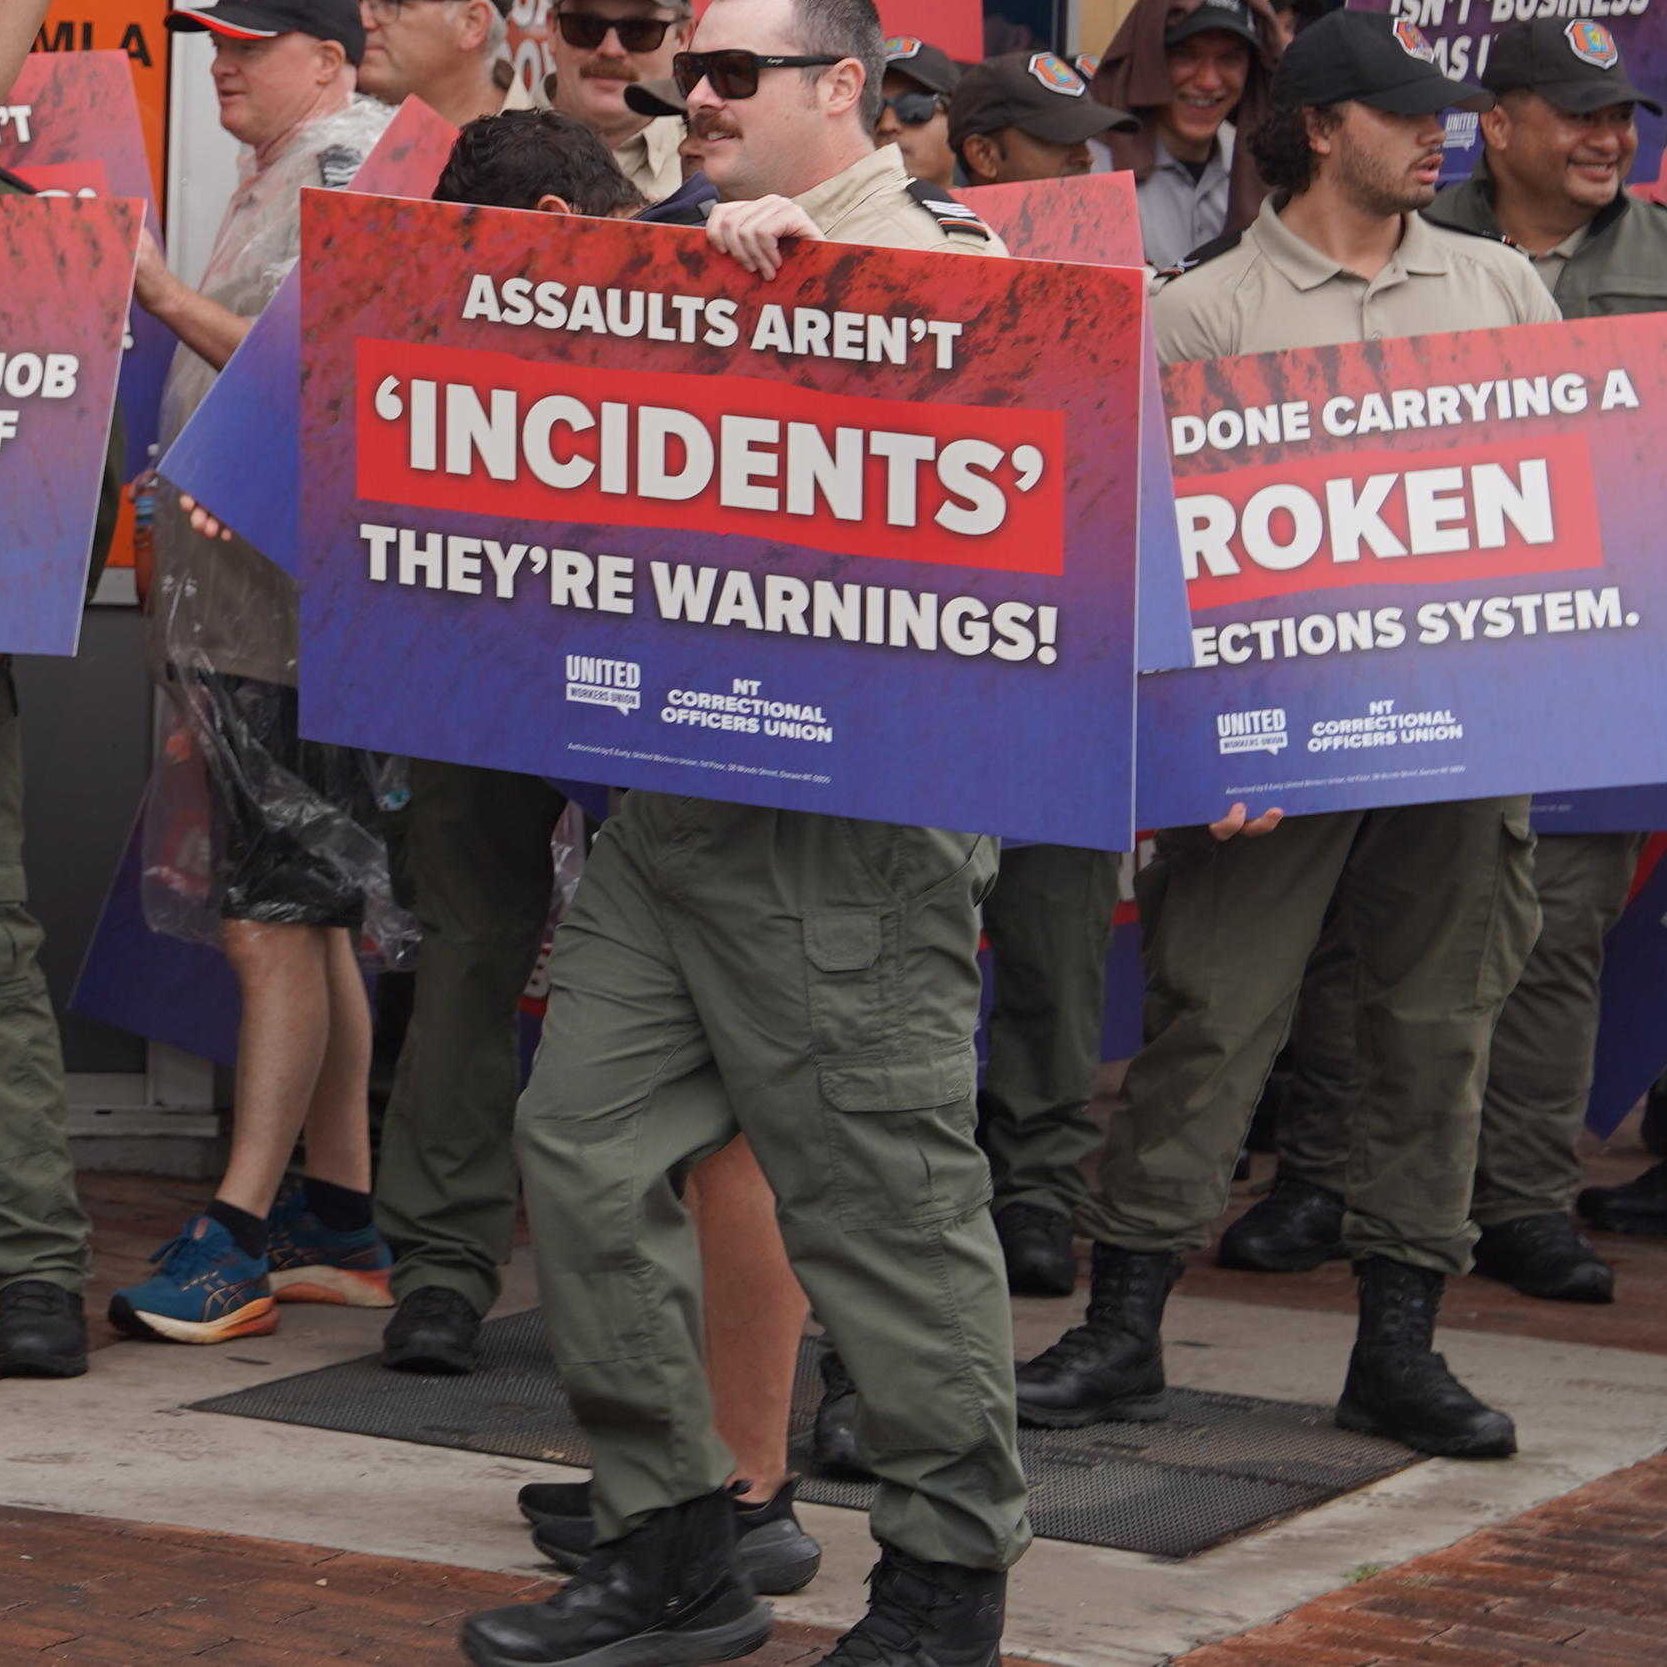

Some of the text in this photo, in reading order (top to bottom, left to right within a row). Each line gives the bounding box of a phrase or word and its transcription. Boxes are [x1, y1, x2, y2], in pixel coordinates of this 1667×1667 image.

[463, 274, 962, 369] ASSAULTS AREN'T
[1172, 370, 1638, 454] DONE CARRYING A
[376, 376, 1043, 534] 'INCIDENTS'
[1175, 459, 1554, 579] ROKEN
[360, 524, 1057, 664] THEY'RE WARNINGS!
[1191, 588, 1639, 667] ECTIONS SYSTEM.
[567, 655, 641, 689] UNITED
[733, 679, 761, 696] NT
[570, 686, 637, 706] WORKERS UNION
[667, 689, 826, 723] CORRECTIONAL
[1369, 700, 1394, 715] NT
[661, 707, 833, 743] OFFICERS UNION
[1217, 708, 1286, 737] UNITED
[1307, 724, 1463, 753] OFFICERS UNION
[1312, 710, 1455, 736] CORRECTIONAL
